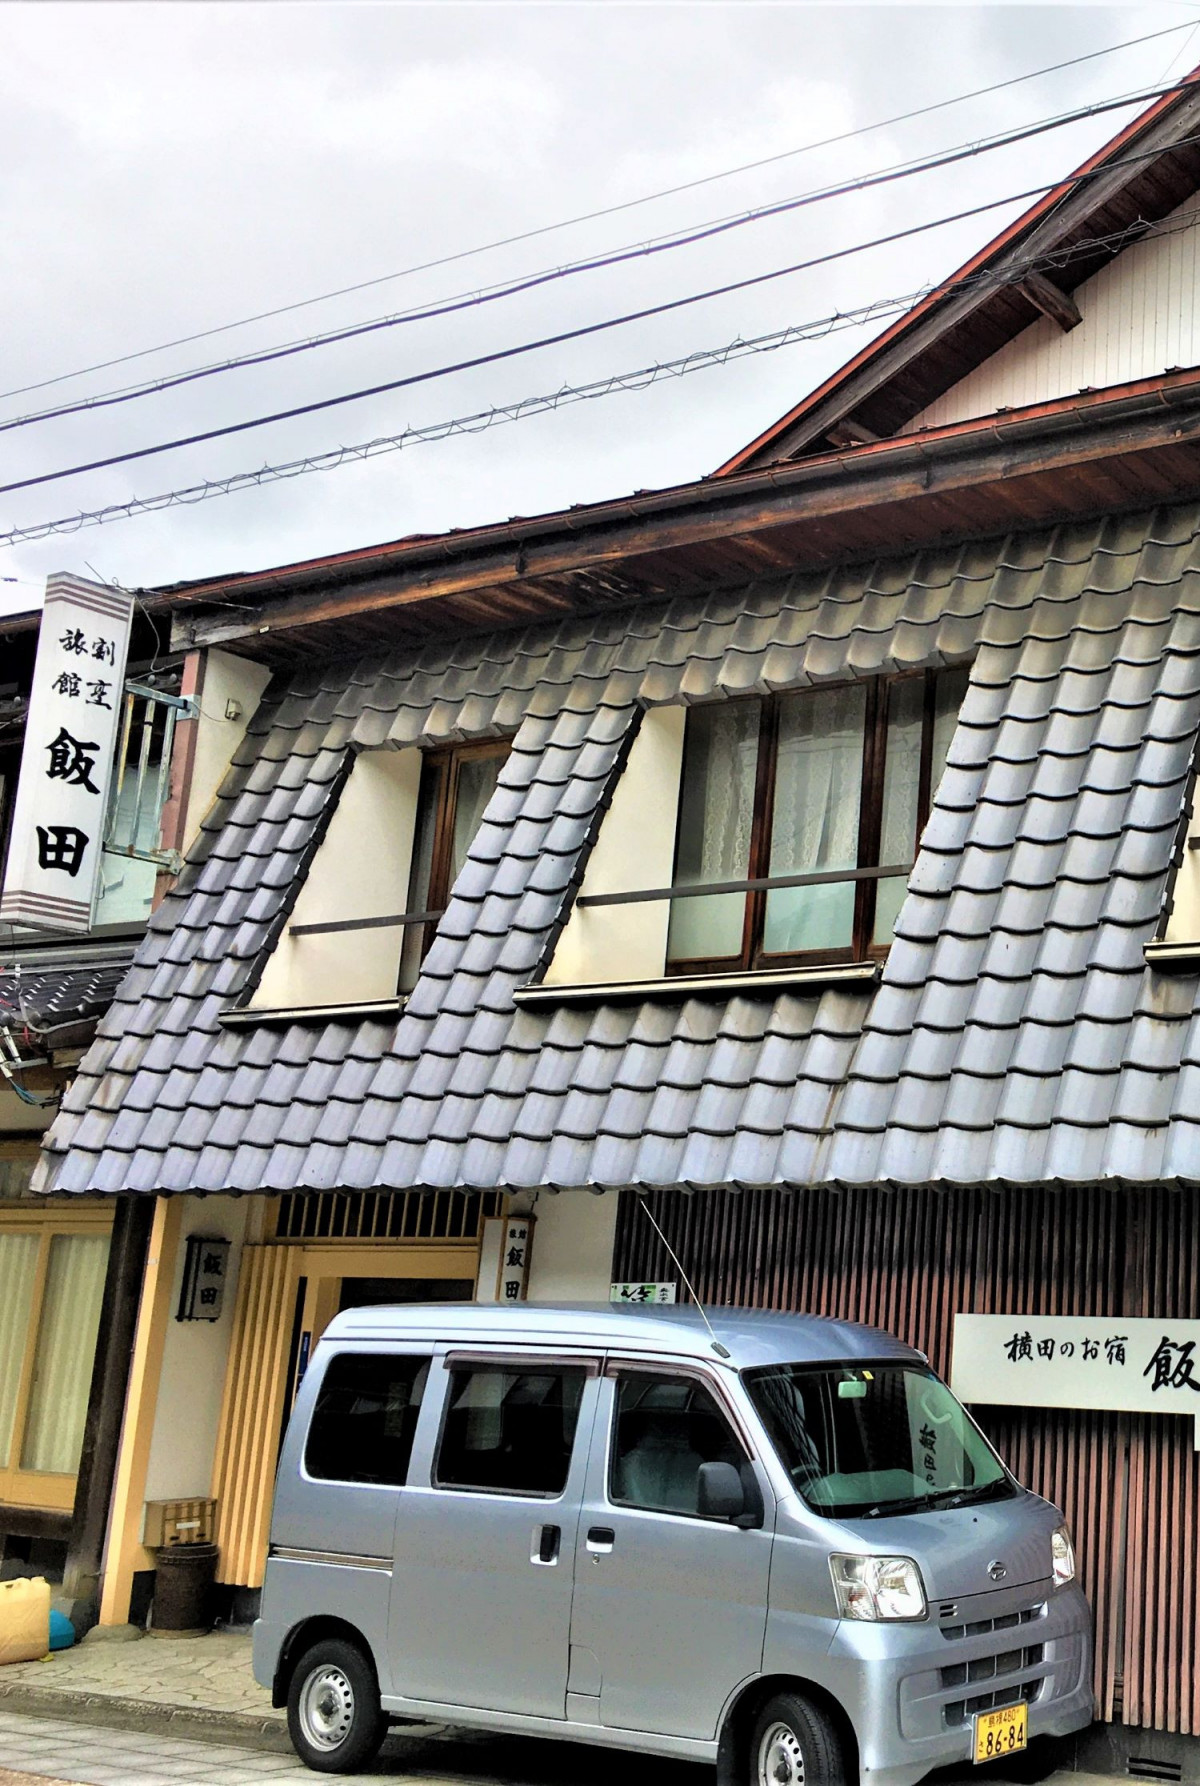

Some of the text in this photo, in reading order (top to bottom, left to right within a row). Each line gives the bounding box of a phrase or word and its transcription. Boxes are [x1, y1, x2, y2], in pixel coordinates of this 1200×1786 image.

[52, 628, 88, 697] 旅館
[36, 727, 100, 877] 飯田
[200, 1252, 223, 1305] 飯田
[505, 1246, 524, 1299] 飯田
[1003, 1331, 1128, 1366] 横田のお宿
[986, 1722, 1023, 1755] 86-84
